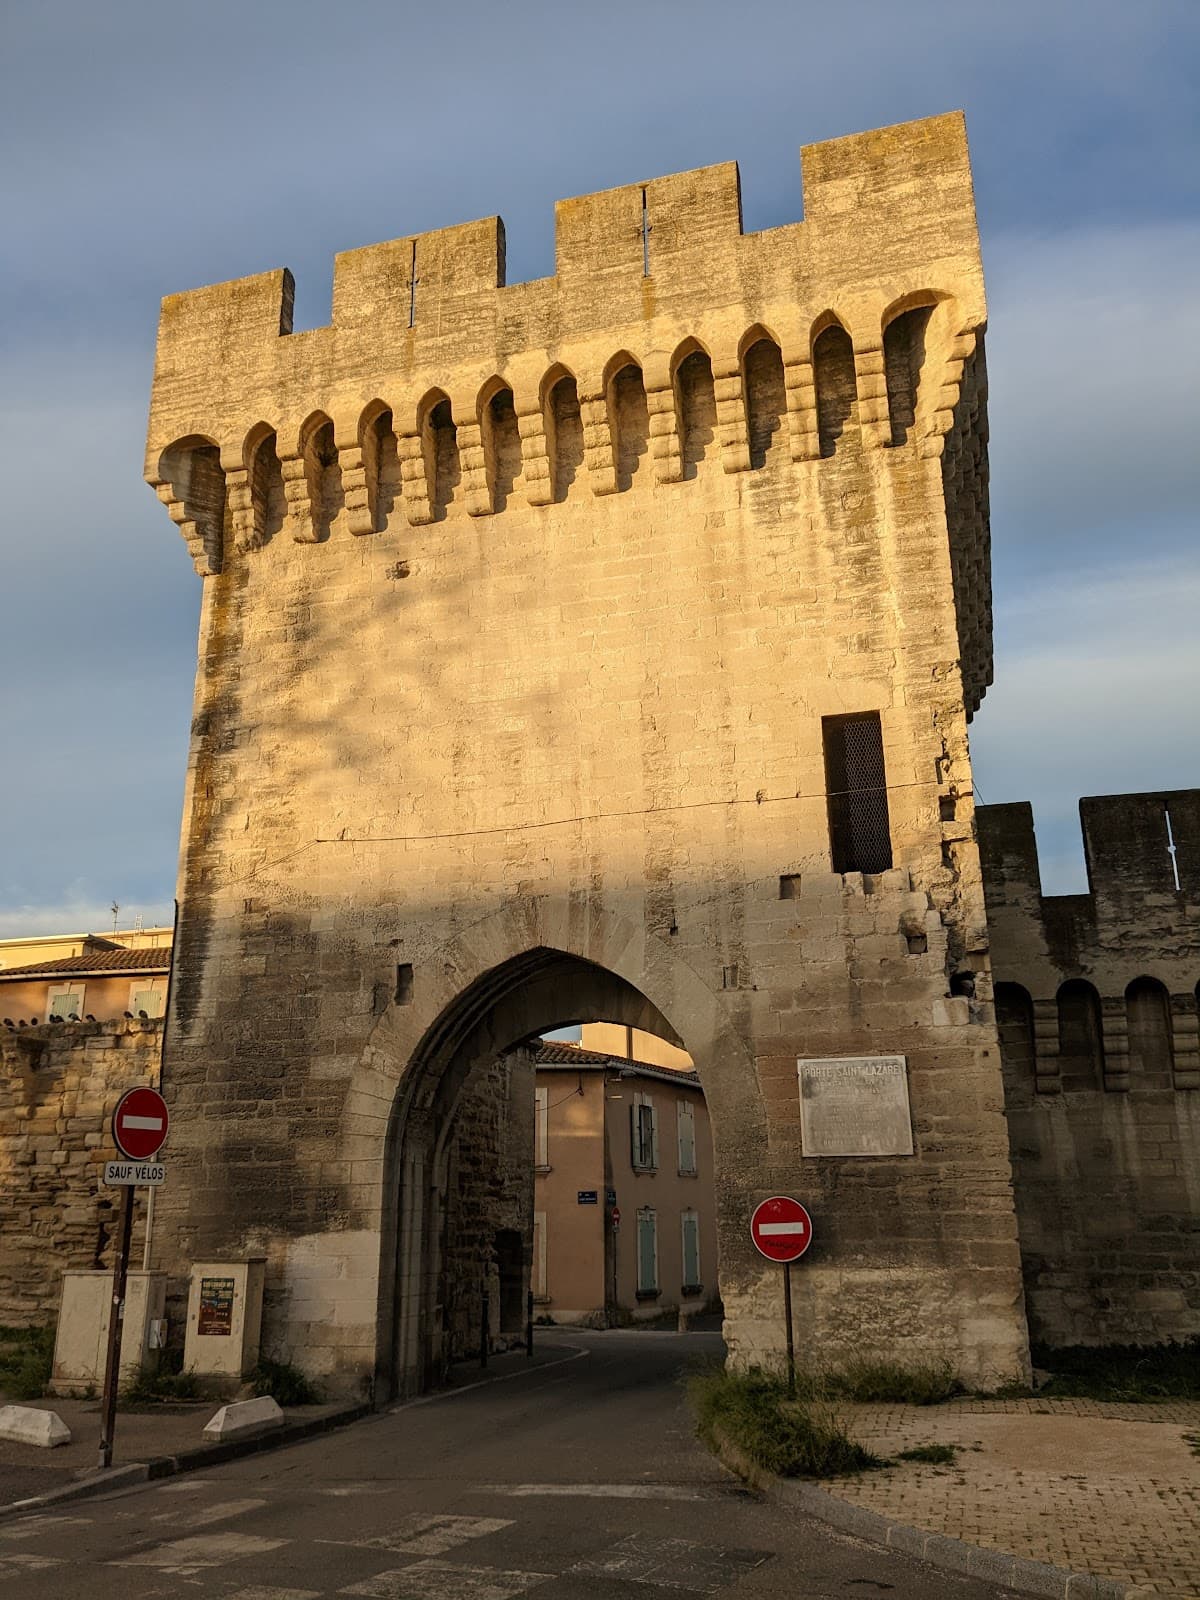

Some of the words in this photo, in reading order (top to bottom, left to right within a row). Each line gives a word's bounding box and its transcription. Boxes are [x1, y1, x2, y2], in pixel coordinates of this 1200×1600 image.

[805, 1067, 833, 1078] PORTE
[108, 1166, 132, 1179] SAUF
[135, 1165, 164, 1180] VÉLOS
